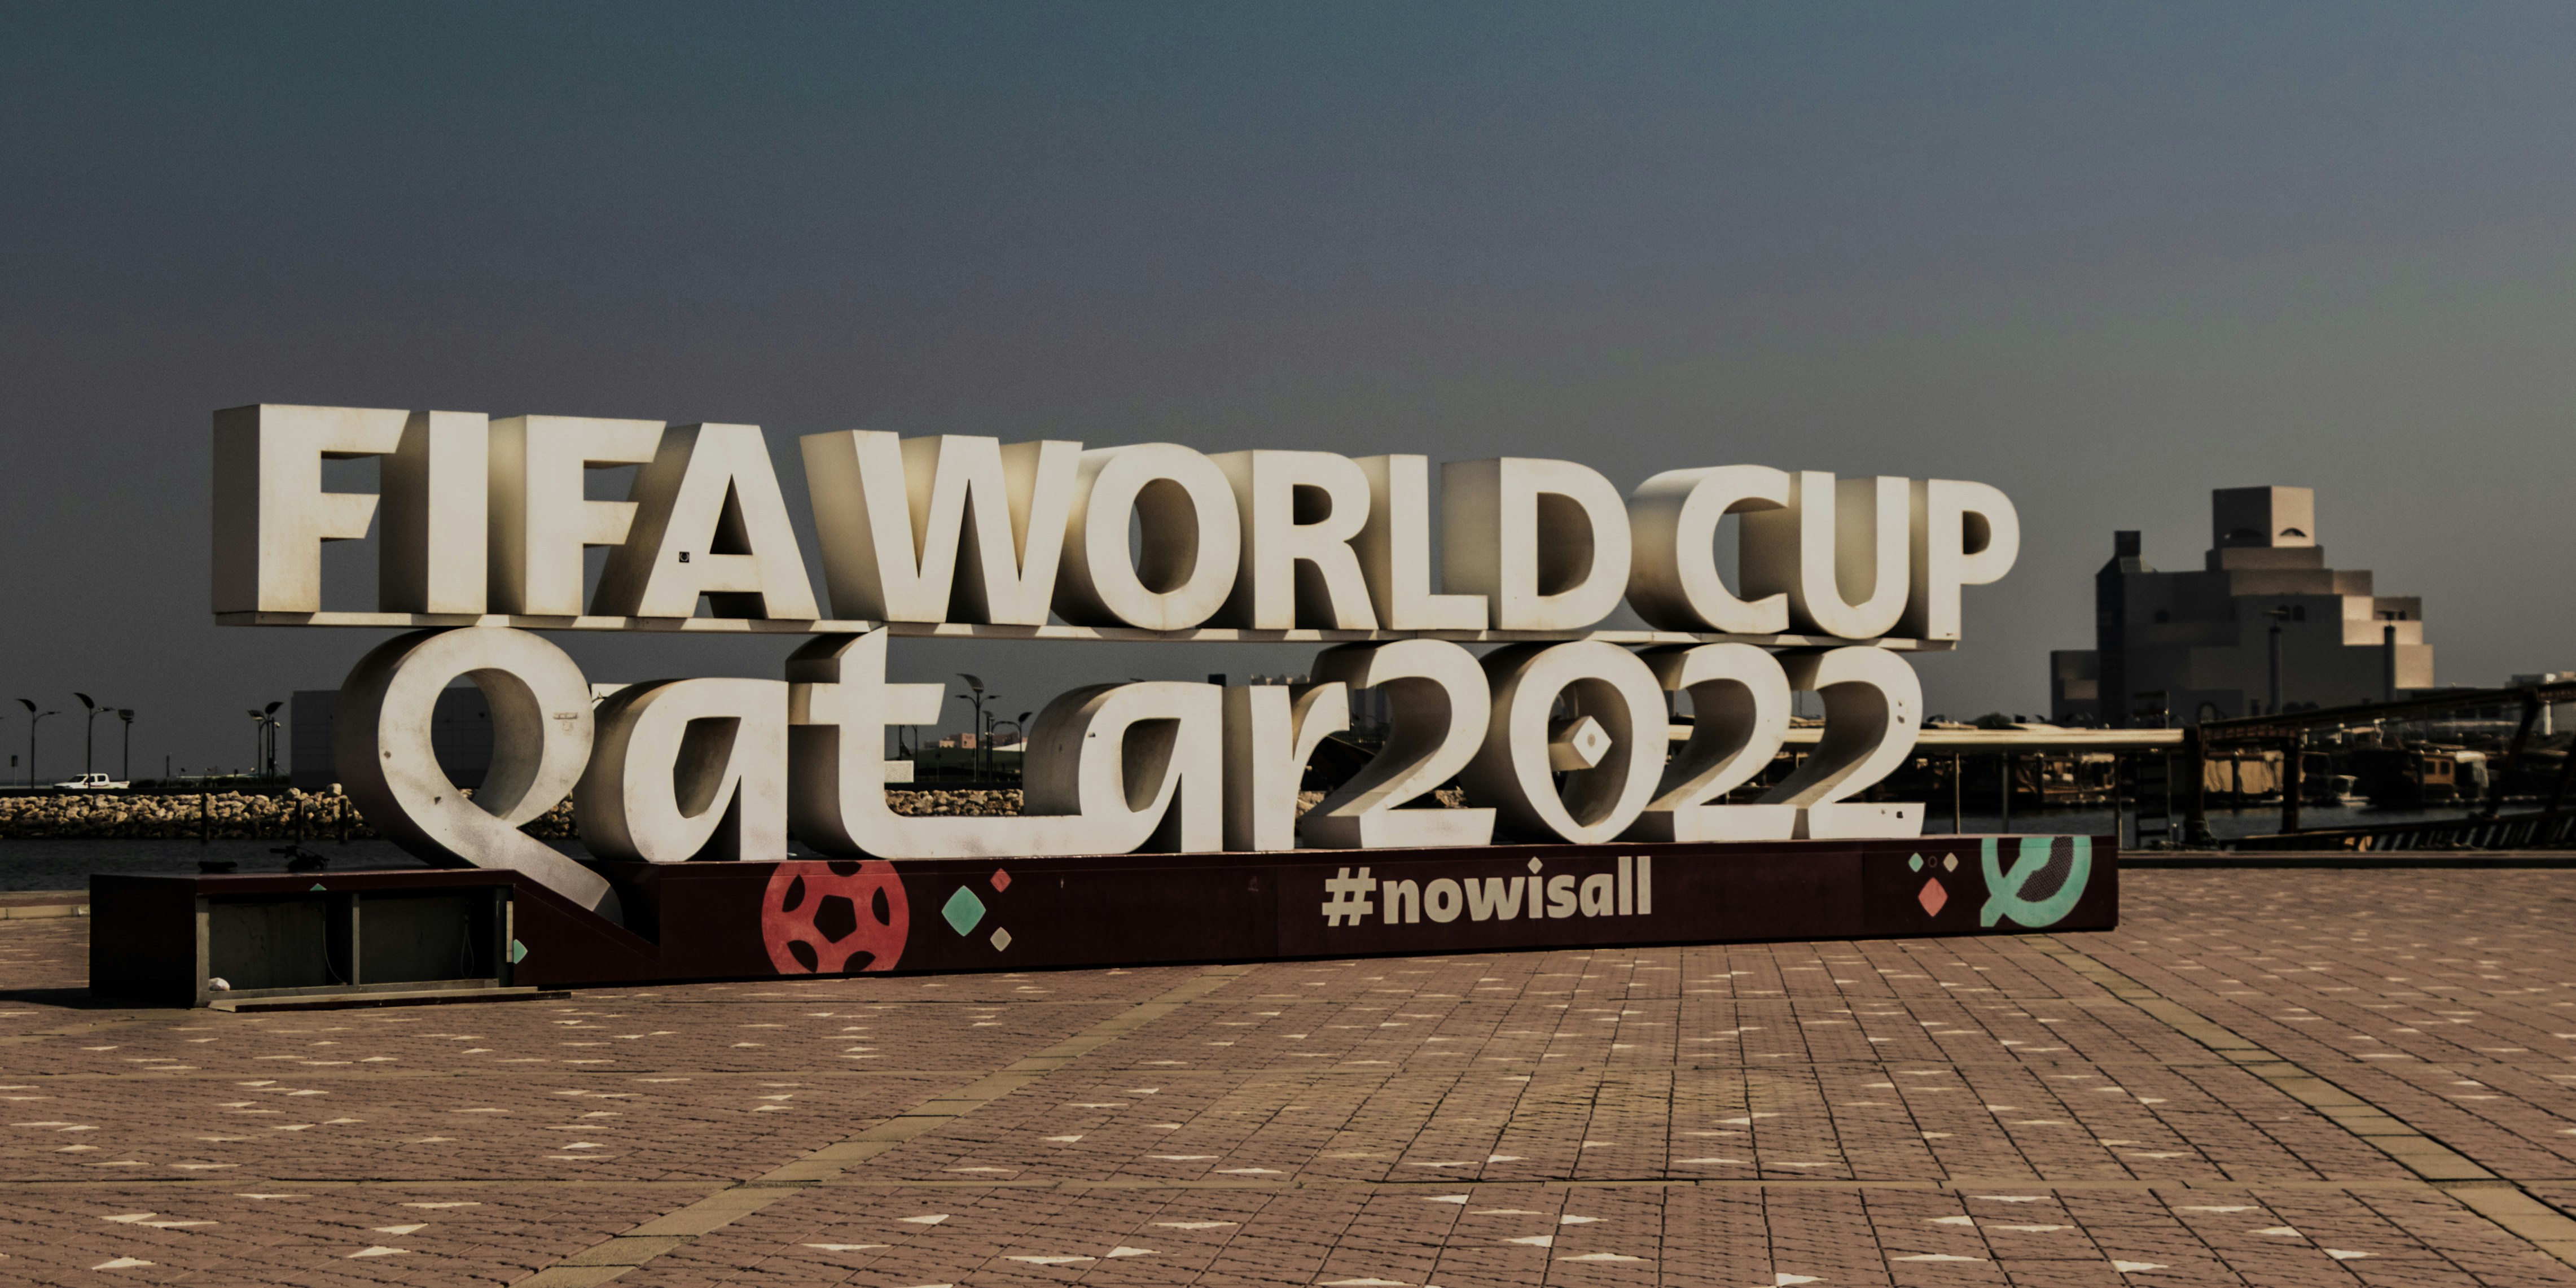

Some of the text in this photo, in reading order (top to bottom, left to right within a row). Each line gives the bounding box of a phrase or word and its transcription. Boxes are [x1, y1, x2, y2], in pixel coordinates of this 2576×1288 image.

[257, 403, 2020, 639] FIFA WORLD CUP
[1322, 856, 1652, 927] #nowisall
